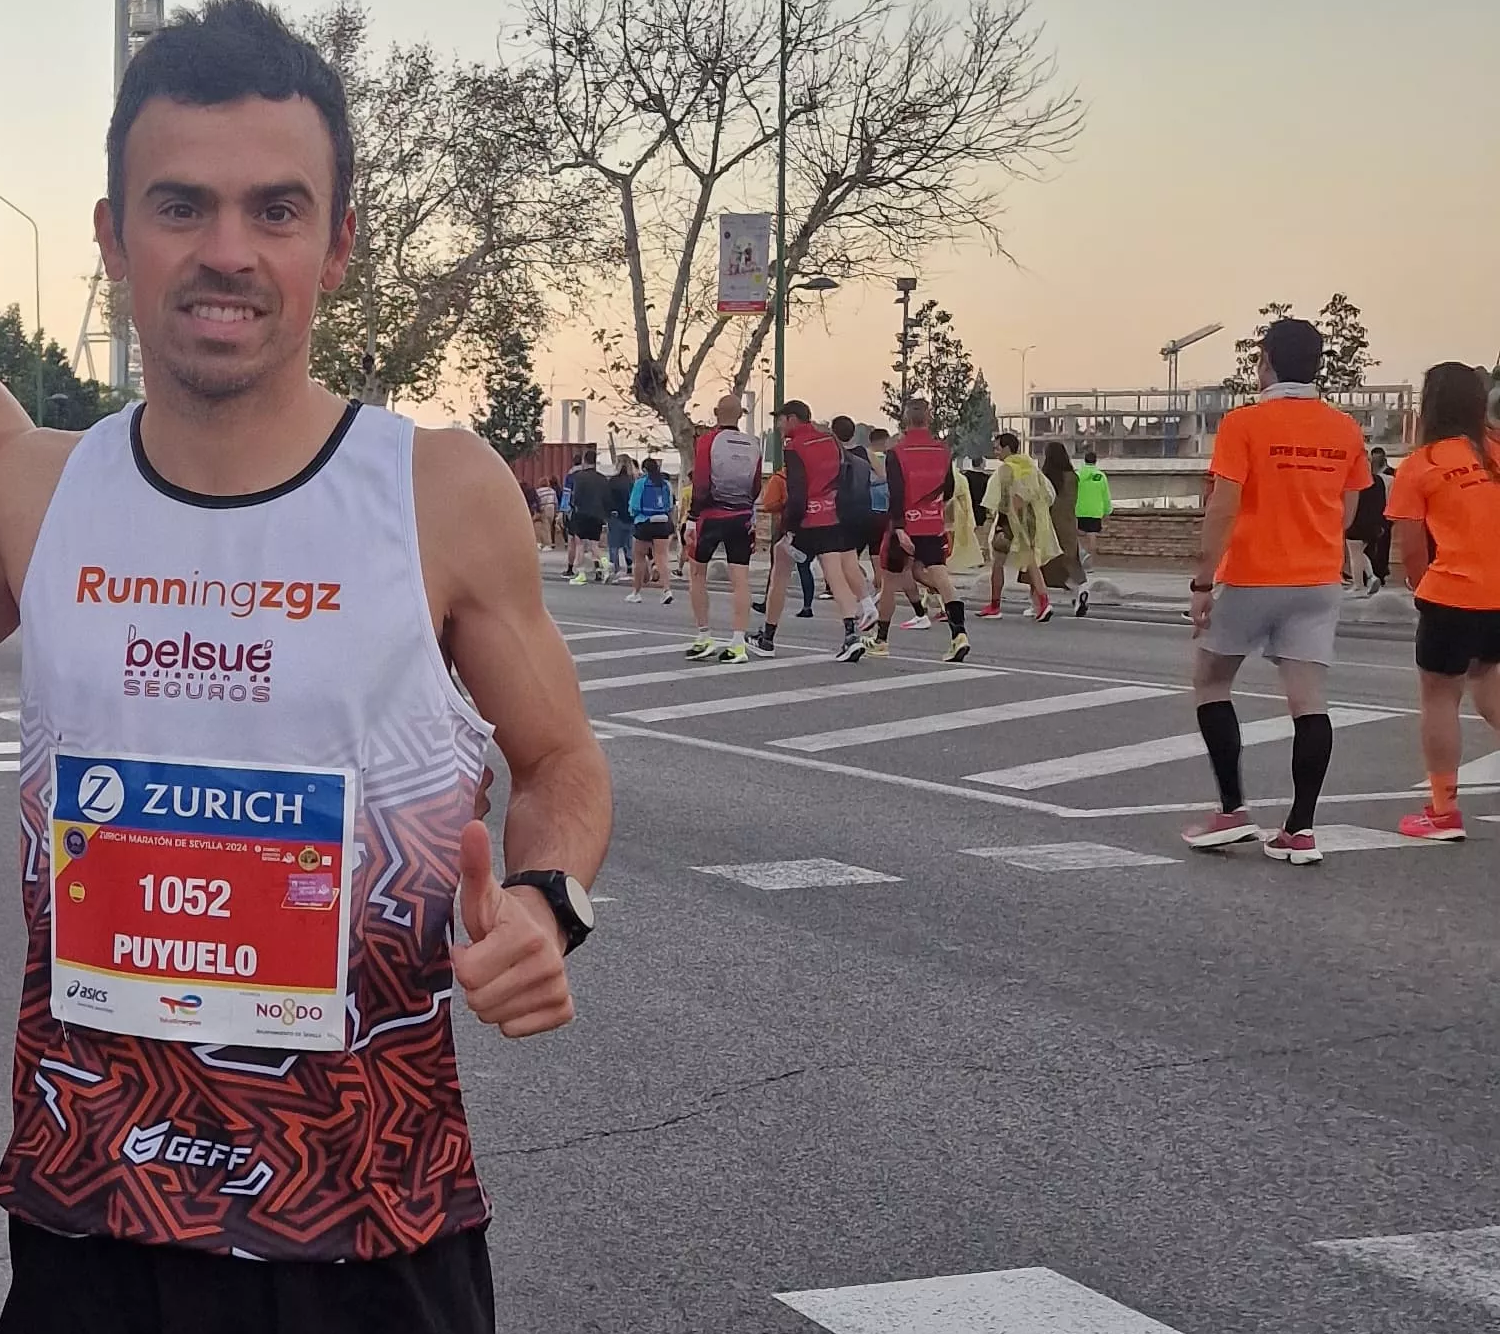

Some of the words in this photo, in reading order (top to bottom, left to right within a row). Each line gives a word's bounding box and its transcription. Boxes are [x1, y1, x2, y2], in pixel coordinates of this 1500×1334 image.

[76, 566, 341, 620] Runningzgz
[141, 783, 304, 825] ZURICH
[99, 830, 127, 843] ZURICH
[128, 834, 173, 848] MARATÓN
[174, 838, 188, 849] DE
[189, 839, 223, 851] SEVILLA
[225, 842, 248, 853] 2024
[138, 873, 232, 918] 1052
[113, 933, 258, 978] PUYUELO
[79, 985, 108, 1003] asics
